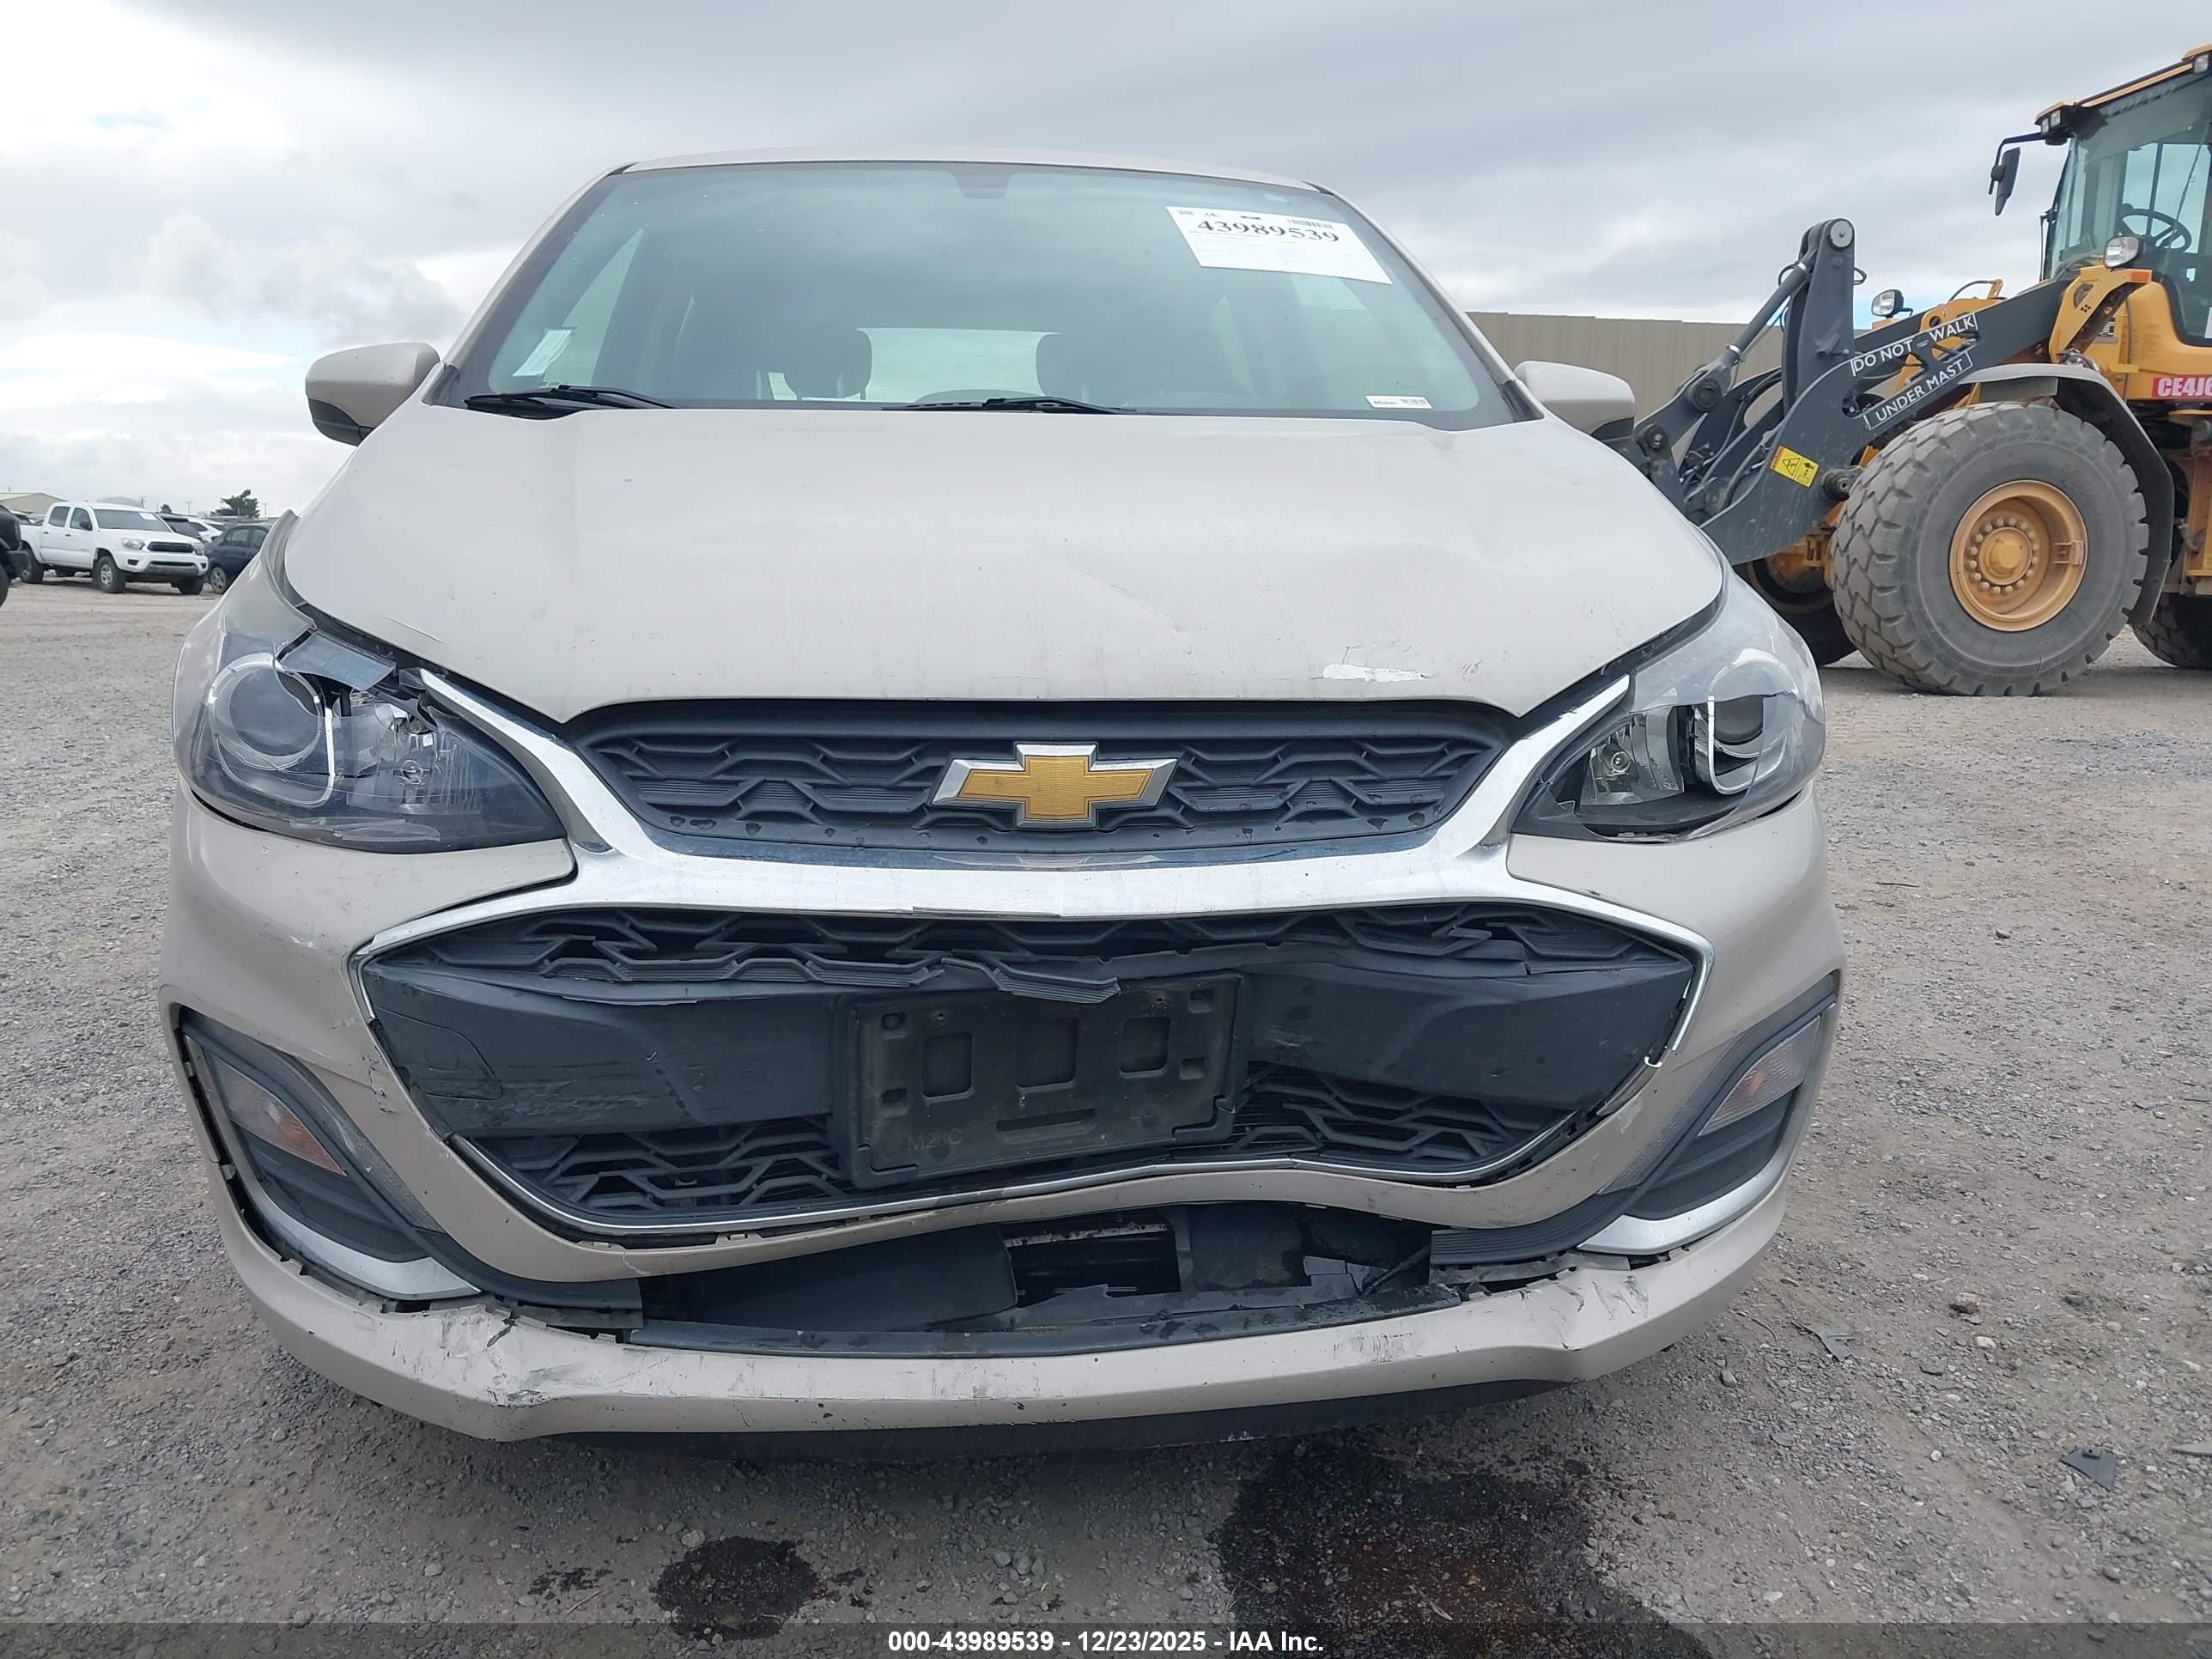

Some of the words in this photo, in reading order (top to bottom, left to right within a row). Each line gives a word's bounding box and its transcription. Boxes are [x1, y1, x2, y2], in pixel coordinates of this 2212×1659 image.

[1197, 220, 1340, 243] 43989539
[1853, 353, 1877, 372] DO
[1881, 340, 1915, 362] NOT
[1929, 316, 1975, 343] WALK
[1875, 386, 1926, 422] UNDER
[1926, 358, 1965, 390] MAST
